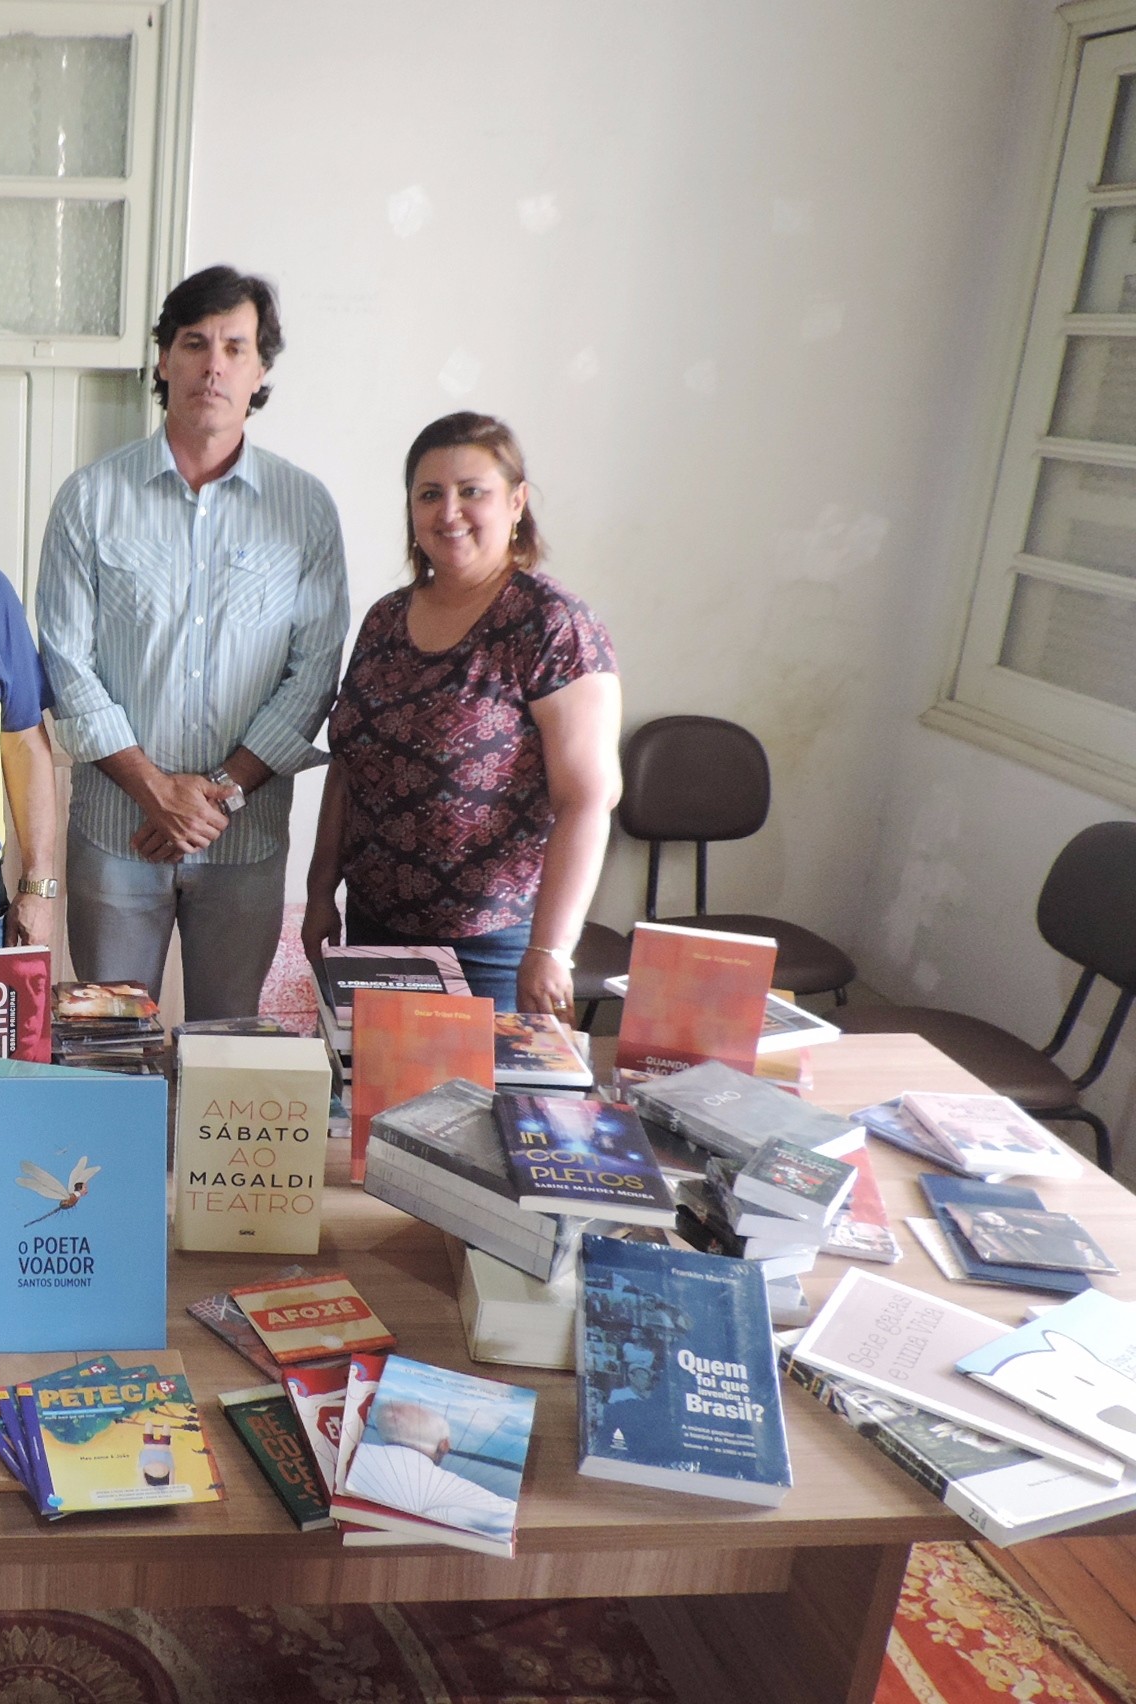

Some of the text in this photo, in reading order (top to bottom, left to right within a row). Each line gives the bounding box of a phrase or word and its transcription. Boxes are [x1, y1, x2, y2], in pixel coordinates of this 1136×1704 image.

[202, 1099, 308, 1121] AMOR
[199, 1122, 309, 1143] SÁBATO
[520, 1131, 548, 1145] IN
[228, 1147, 276, 1168] AO
[526, 1149, 601, 1166] COM
[189, 1171, 313, 1189] MAGALDI
[529, 1166, 644, 1190] PLETOS
[534, 1182, 655, 1200] SABINE MENDES MOURA
[185, 1191, 314, 1215] TEATRO
[34, 1236, 91, 1254] POETA
[18, 1257, 95, 1275] VOADOR
[671, 1267, 704, 1280] Franklin
[17, 1278, 92, 1288] SANTOS DUMONT
[267, 1298, 356, 1325] AFOXÉ
[847, 1333, 887, 1369] Sete
[677, 1349, 748, 1380] Quem
[696, 1373, 750, 1393] foi que
[38, 1381, 168, 1408] PETECA
[697, 1386, 741, 1402] inventou
[685, 1393, 765, 1423] Brasil?
